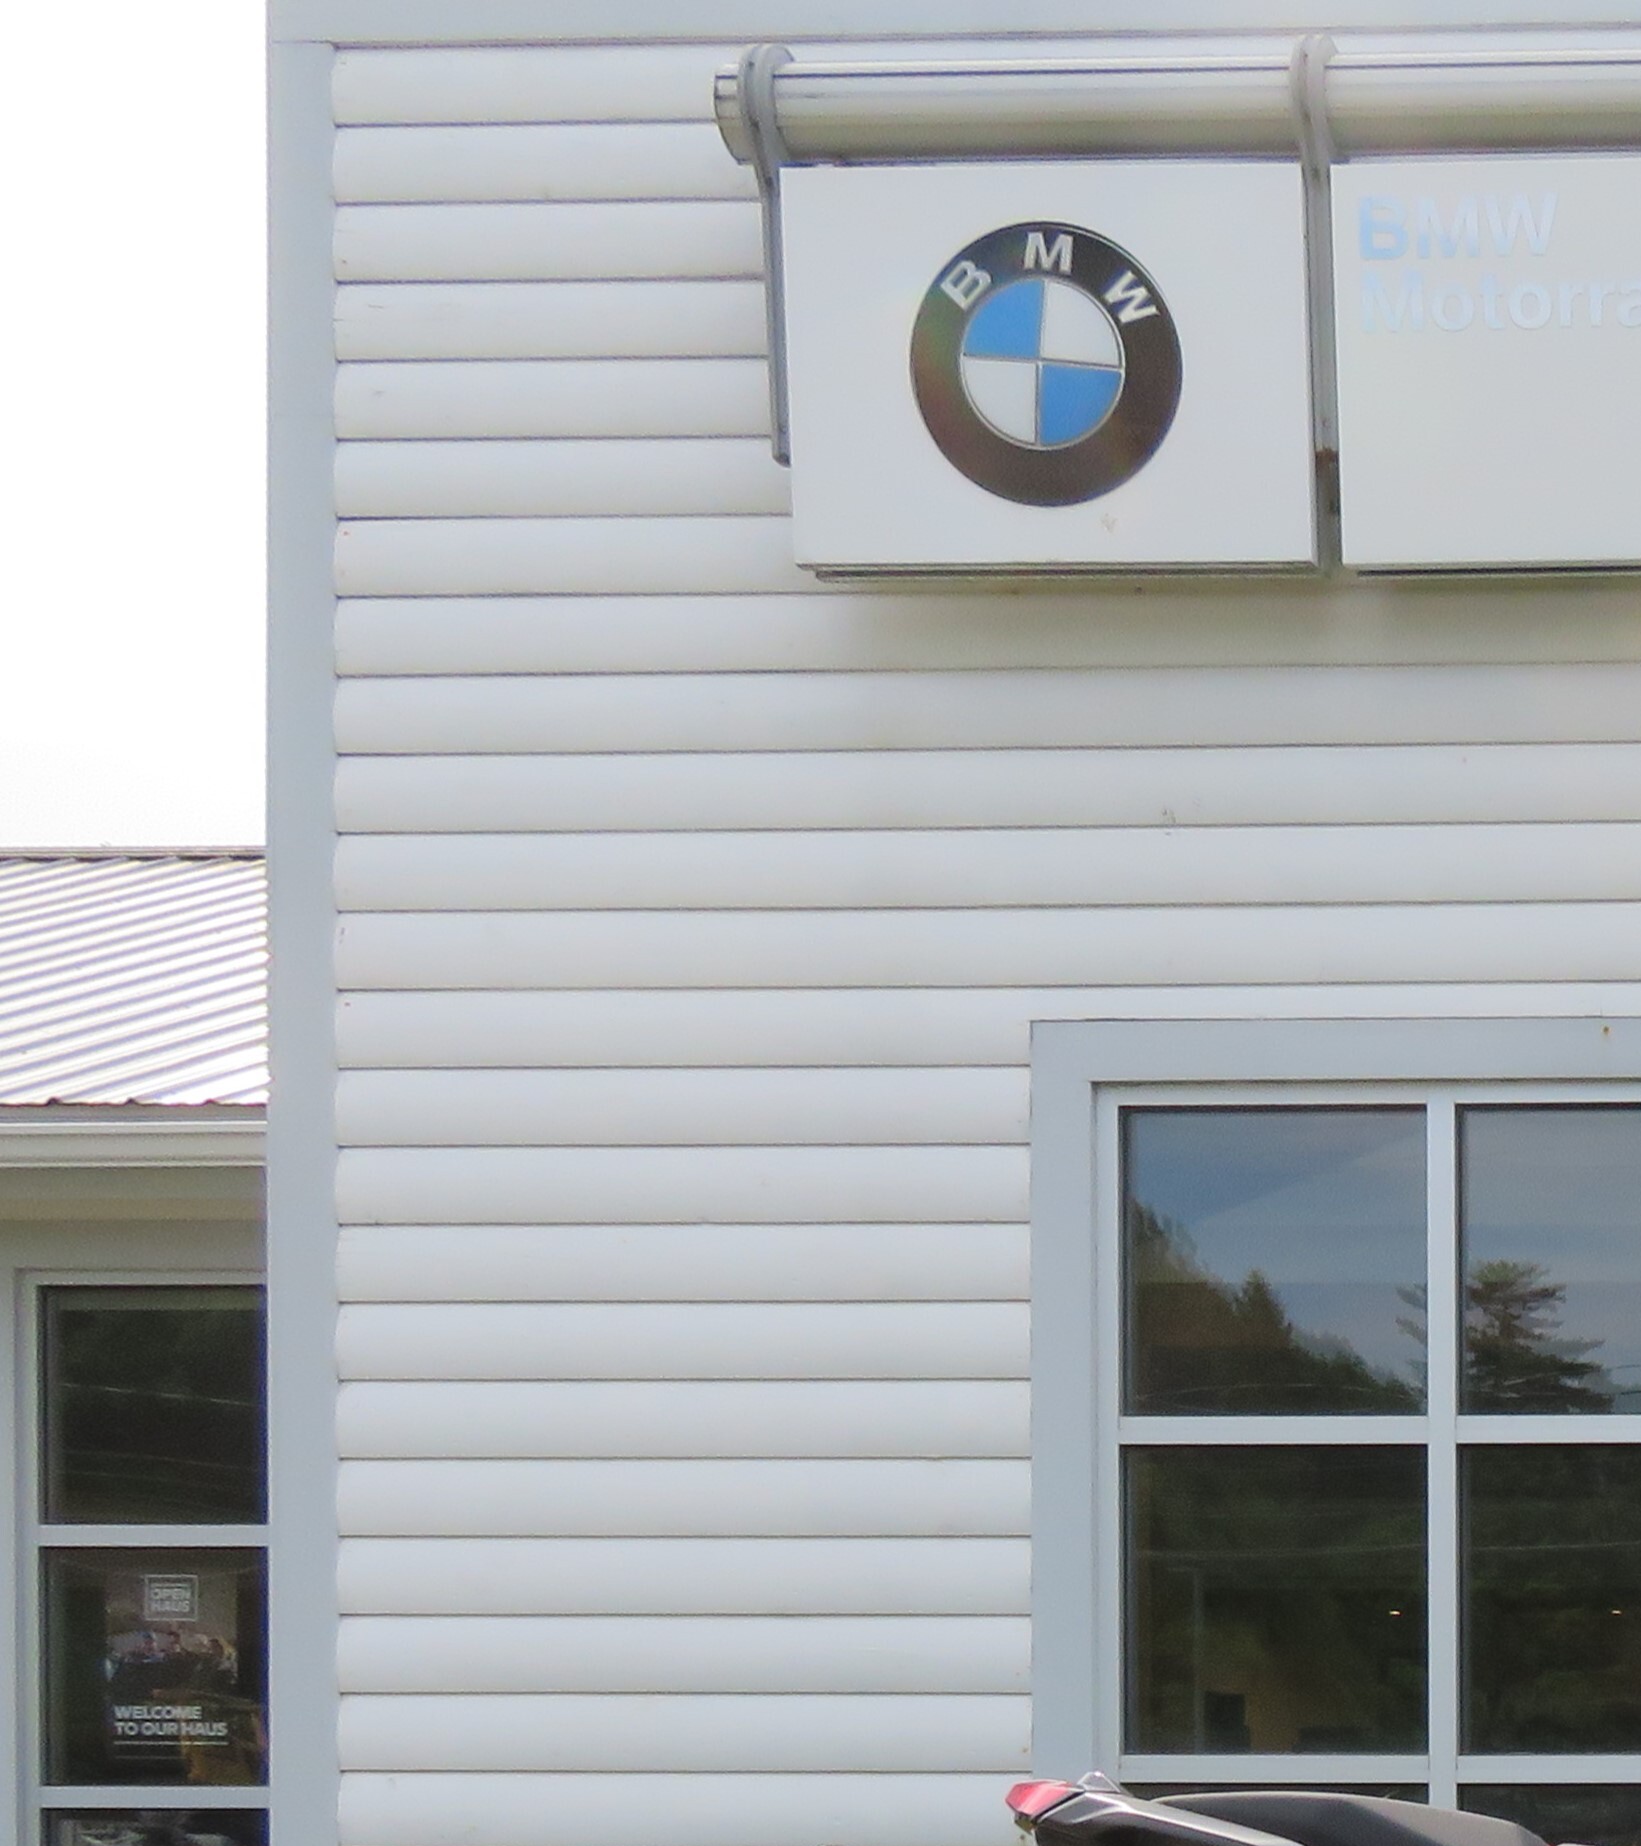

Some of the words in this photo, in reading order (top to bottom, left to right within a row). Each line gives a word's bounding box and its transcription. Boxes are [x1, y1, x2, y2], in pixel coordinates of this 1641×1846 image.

[1358, 191, 1558, 260] BMW
[939, 231, 1161, 324] BMW
[114, 1705, 202, 1719] WELCOME
[114, 1722, 138, 1735] TO
[142, 1722, 178, 1735] OUR
[181, 1722, 229, 1736] HAUS
